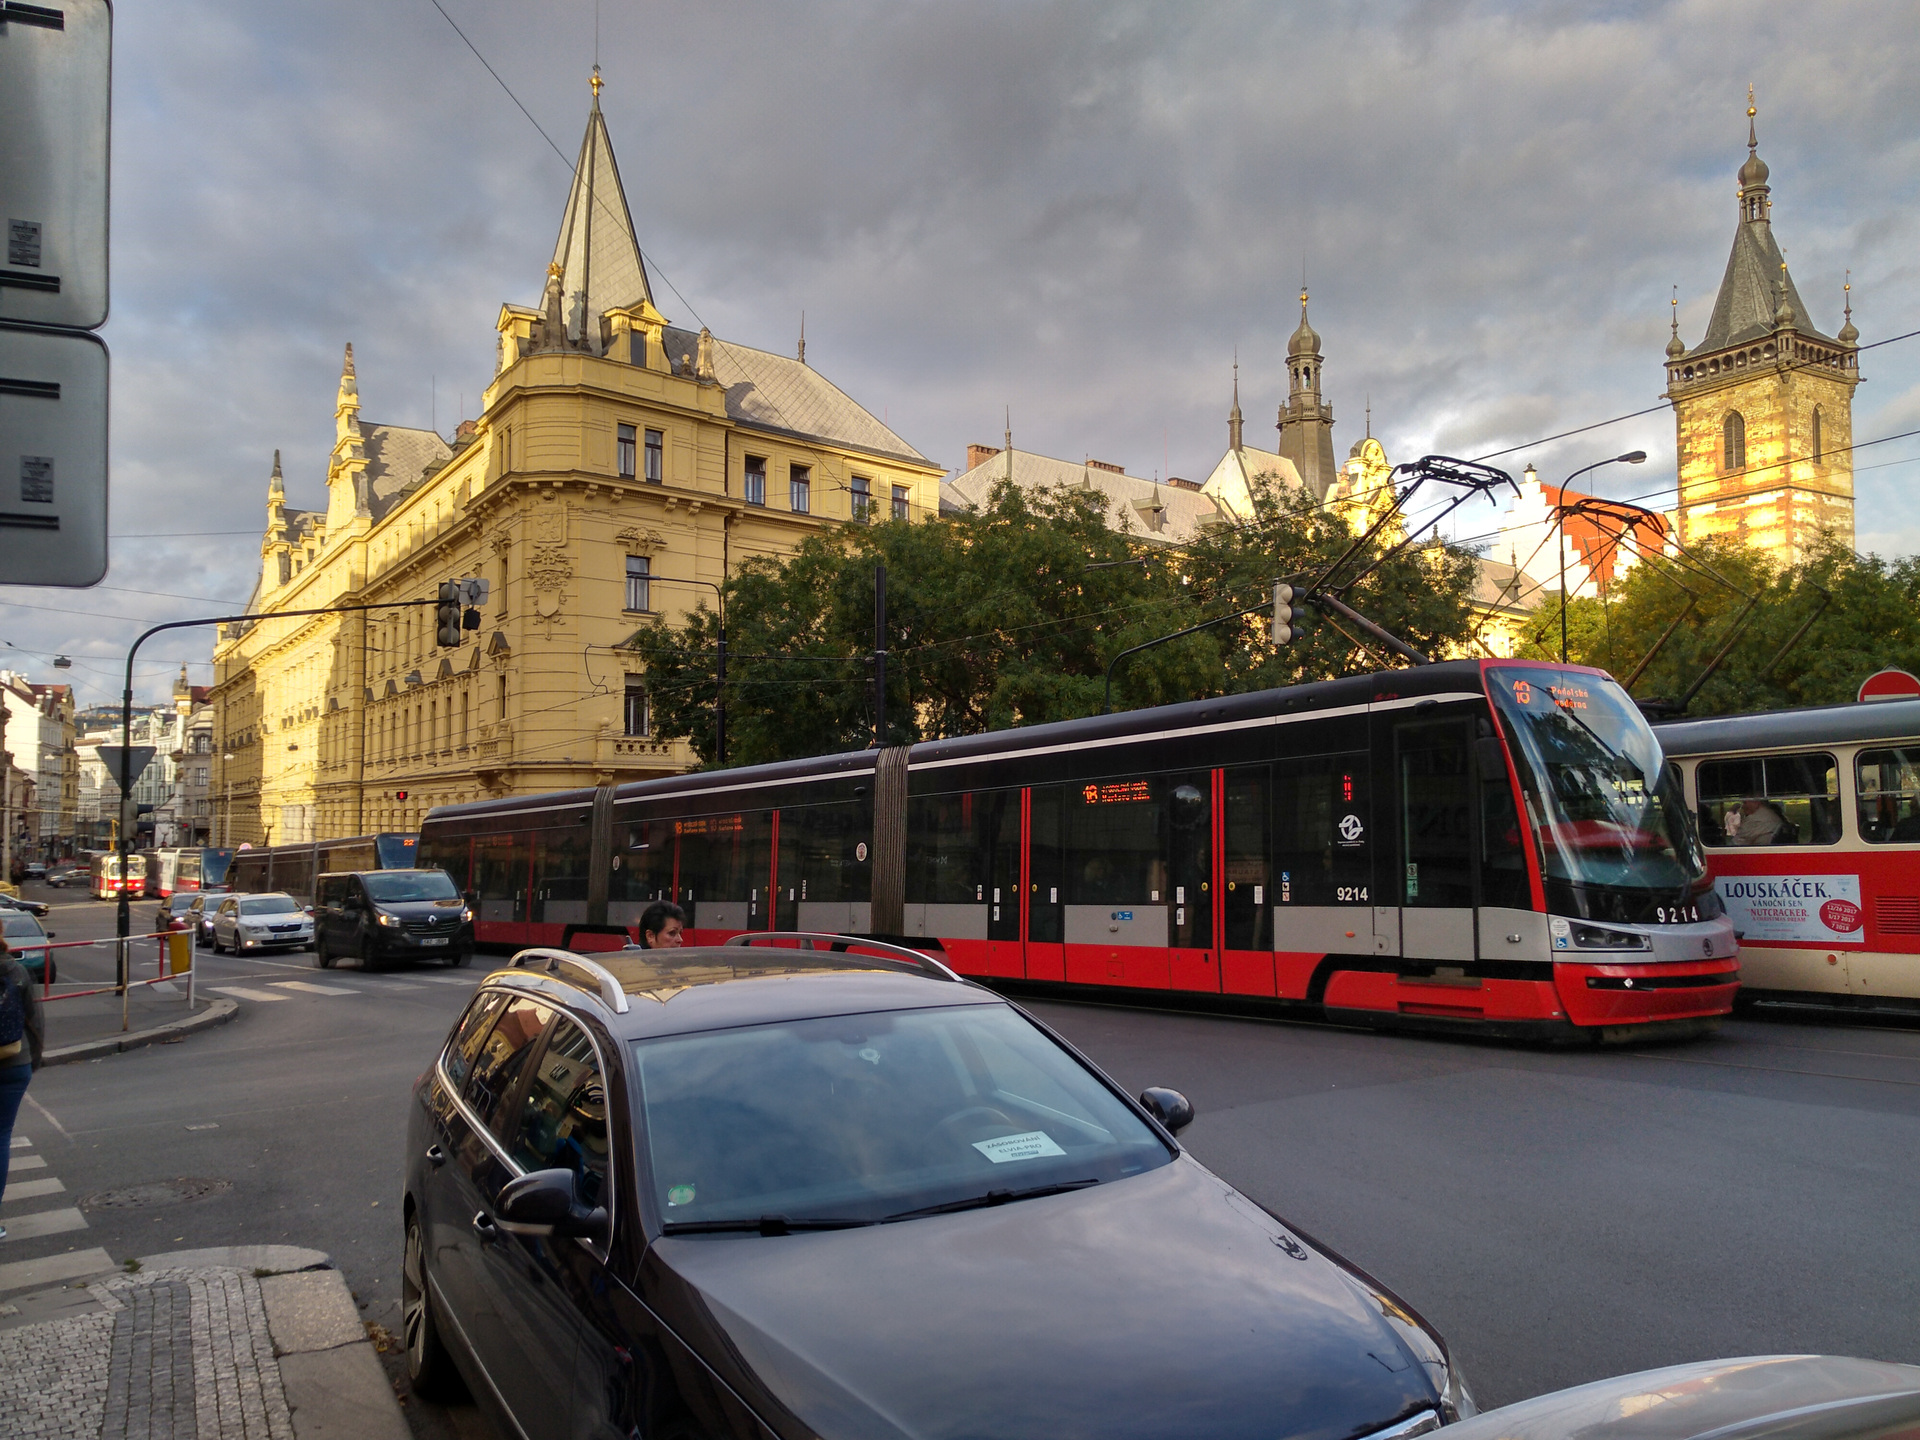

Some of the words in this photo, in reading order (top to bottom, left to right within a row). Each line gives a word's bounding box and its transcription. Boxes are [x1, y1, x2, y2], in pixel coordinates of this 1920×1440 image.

[403, 838, 415, 847] 22
[1337, 887, 1369, 902] 9214
[1724, 877, 1832, 899] LOUSKÁČEK,
[1752, 898, 1786, 907] VÁNOČNÍ
[1656, 906, 1699, 923] 9214
[1841, 915, 1855, 923] 2017
[986, 1135, 1041, 1149] ZÁSOBOVÁNÍ
